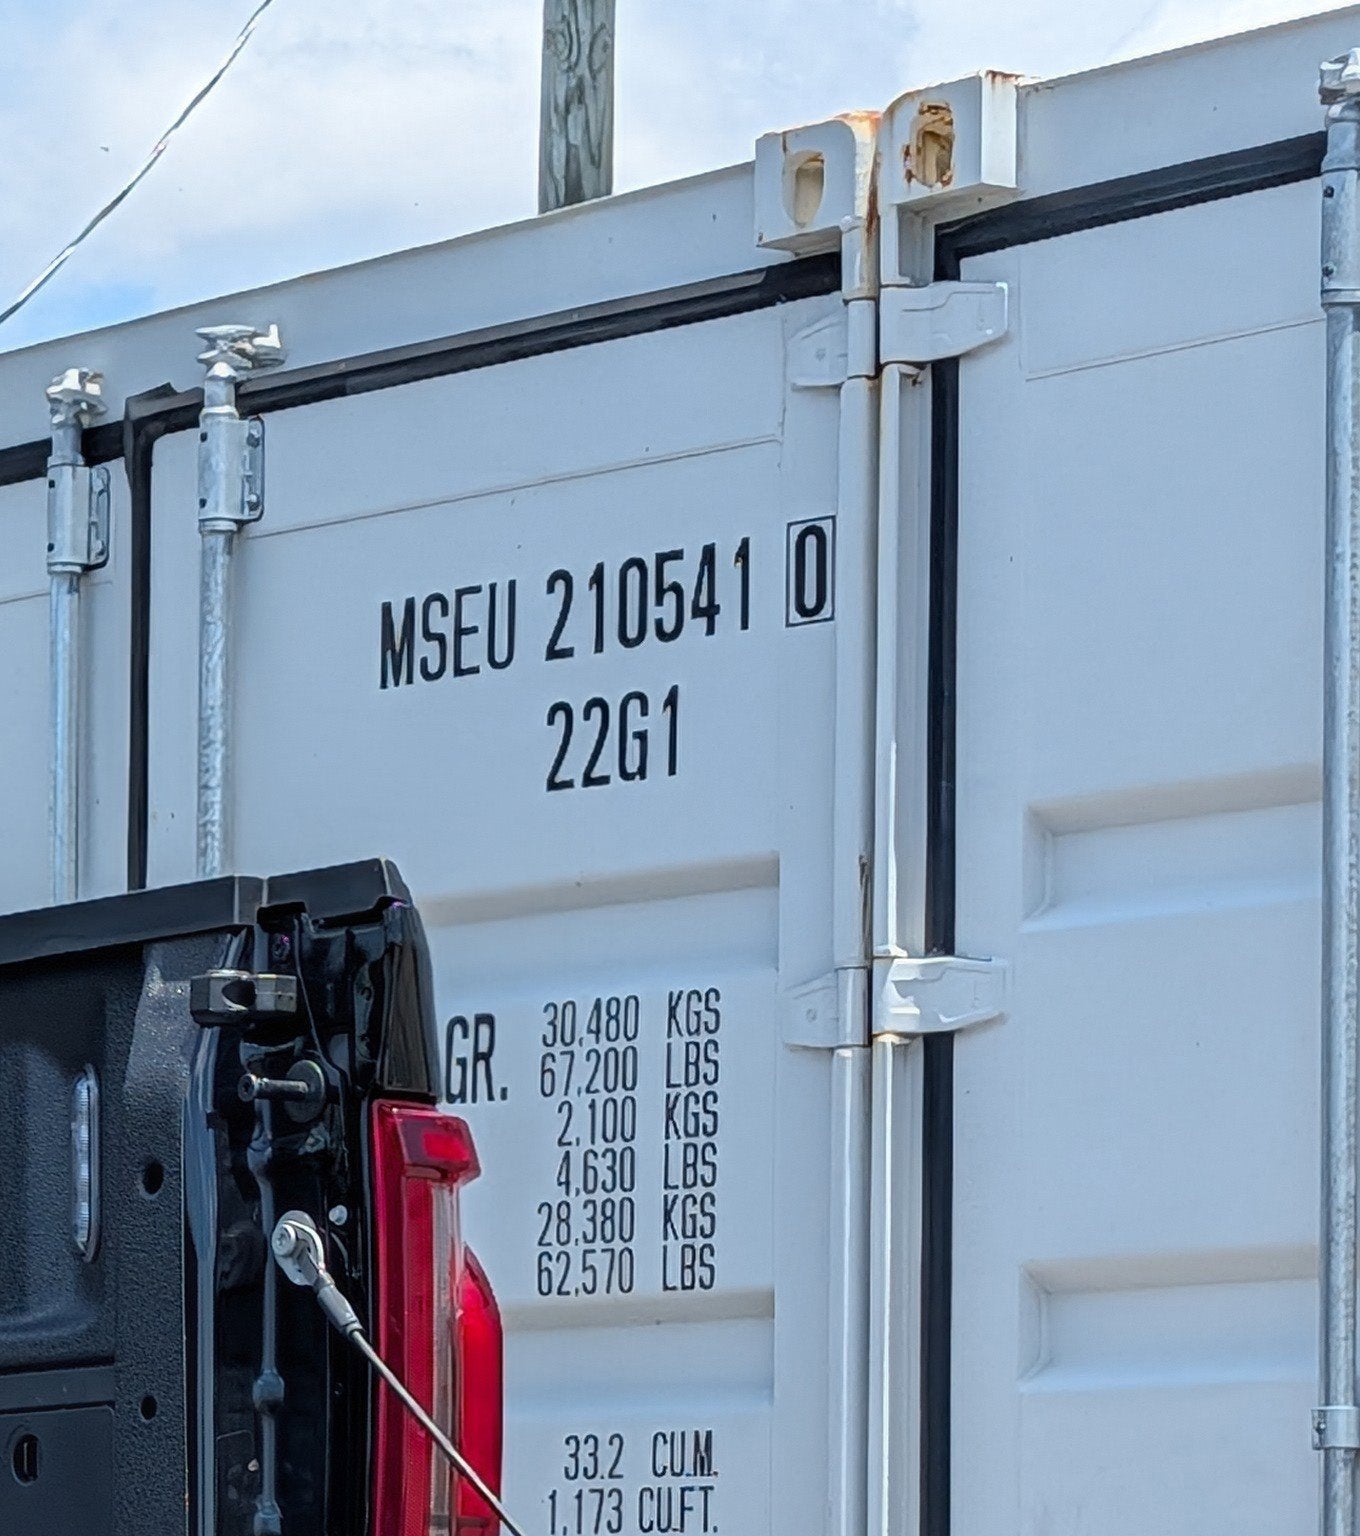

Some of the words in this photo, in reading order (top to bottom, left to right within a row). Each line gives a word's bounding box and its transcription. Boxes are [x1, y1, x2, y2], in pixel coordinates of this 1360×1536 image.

[379, 579, 517, 690] MSEU
[545, 536, 750, 662] 210541
[794, 523, 828, 619] 0
[546, 684, 679, 792] 22G1
[541, 994, 640, 1048] 30,480
[666, 987, 721, 1039] KGS
[444, 1012, 509, 1105] GR.
[540, 1045, 638, 1098] 67,200
[665, 1038, 720, 1089] LBS
[557, 1095, 637, 1148] 2,100
[664, 1090, 719, 1141] KGS
[556, 1145, 636, 1198] 4,630
[663, 1141, 718, 1191] LBS
[537, 1196, 635, 1248] 28,380
[662, 1191, 716, 1242] KGS
[537, 1246, 635, 1298] 62,570
[662, 1243, 716, 1292] LBS
[563, 1432, 625, 1481] 33.2
[548, 1487, 623, 1536] 1,173
